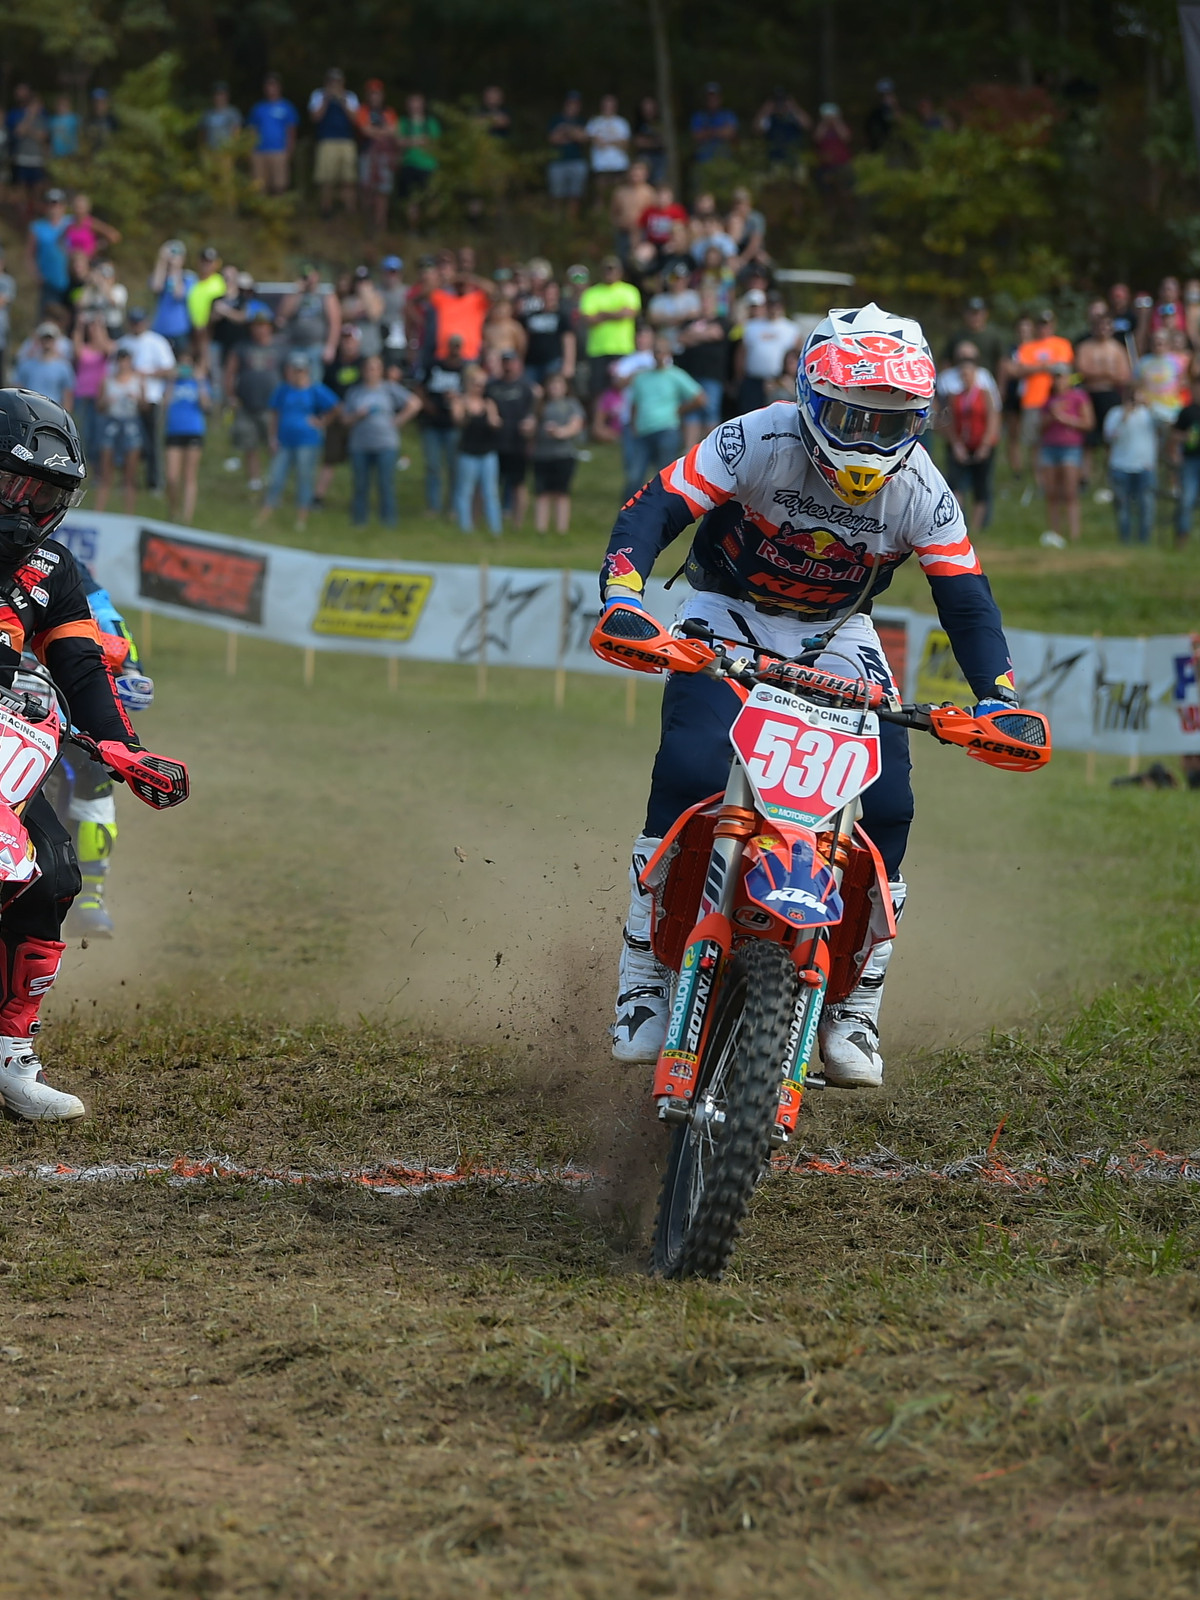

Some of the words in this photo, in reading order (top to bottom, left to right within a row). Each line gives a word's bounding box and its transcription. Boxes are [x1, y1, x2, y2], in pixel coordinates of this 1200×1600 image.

[799, 496, 829, 518] Lee
[828, 506, 888, 536] Designs
[756, 539, 812, 576] Red
[810, 560, 866, 583] Bull
[747, 572, 850, 604] KTM
[599, 640, 670, 667] ACERBIS
[767, 662, 874, 700] RENTHAL
[748, 718, 870, 808] 530
[968, 738, 1041, 760] ACERBIS
[125, 765, 170, 790] ACERBIS
[778, 808, 816, 825] MOTOREX
[738, 909, 770, 924] RB
[766, 887, 828, 915] KTM
[666, 969, 693, 1047] MOTOREX
[802, 988, 825, 1062] MOTOREX
